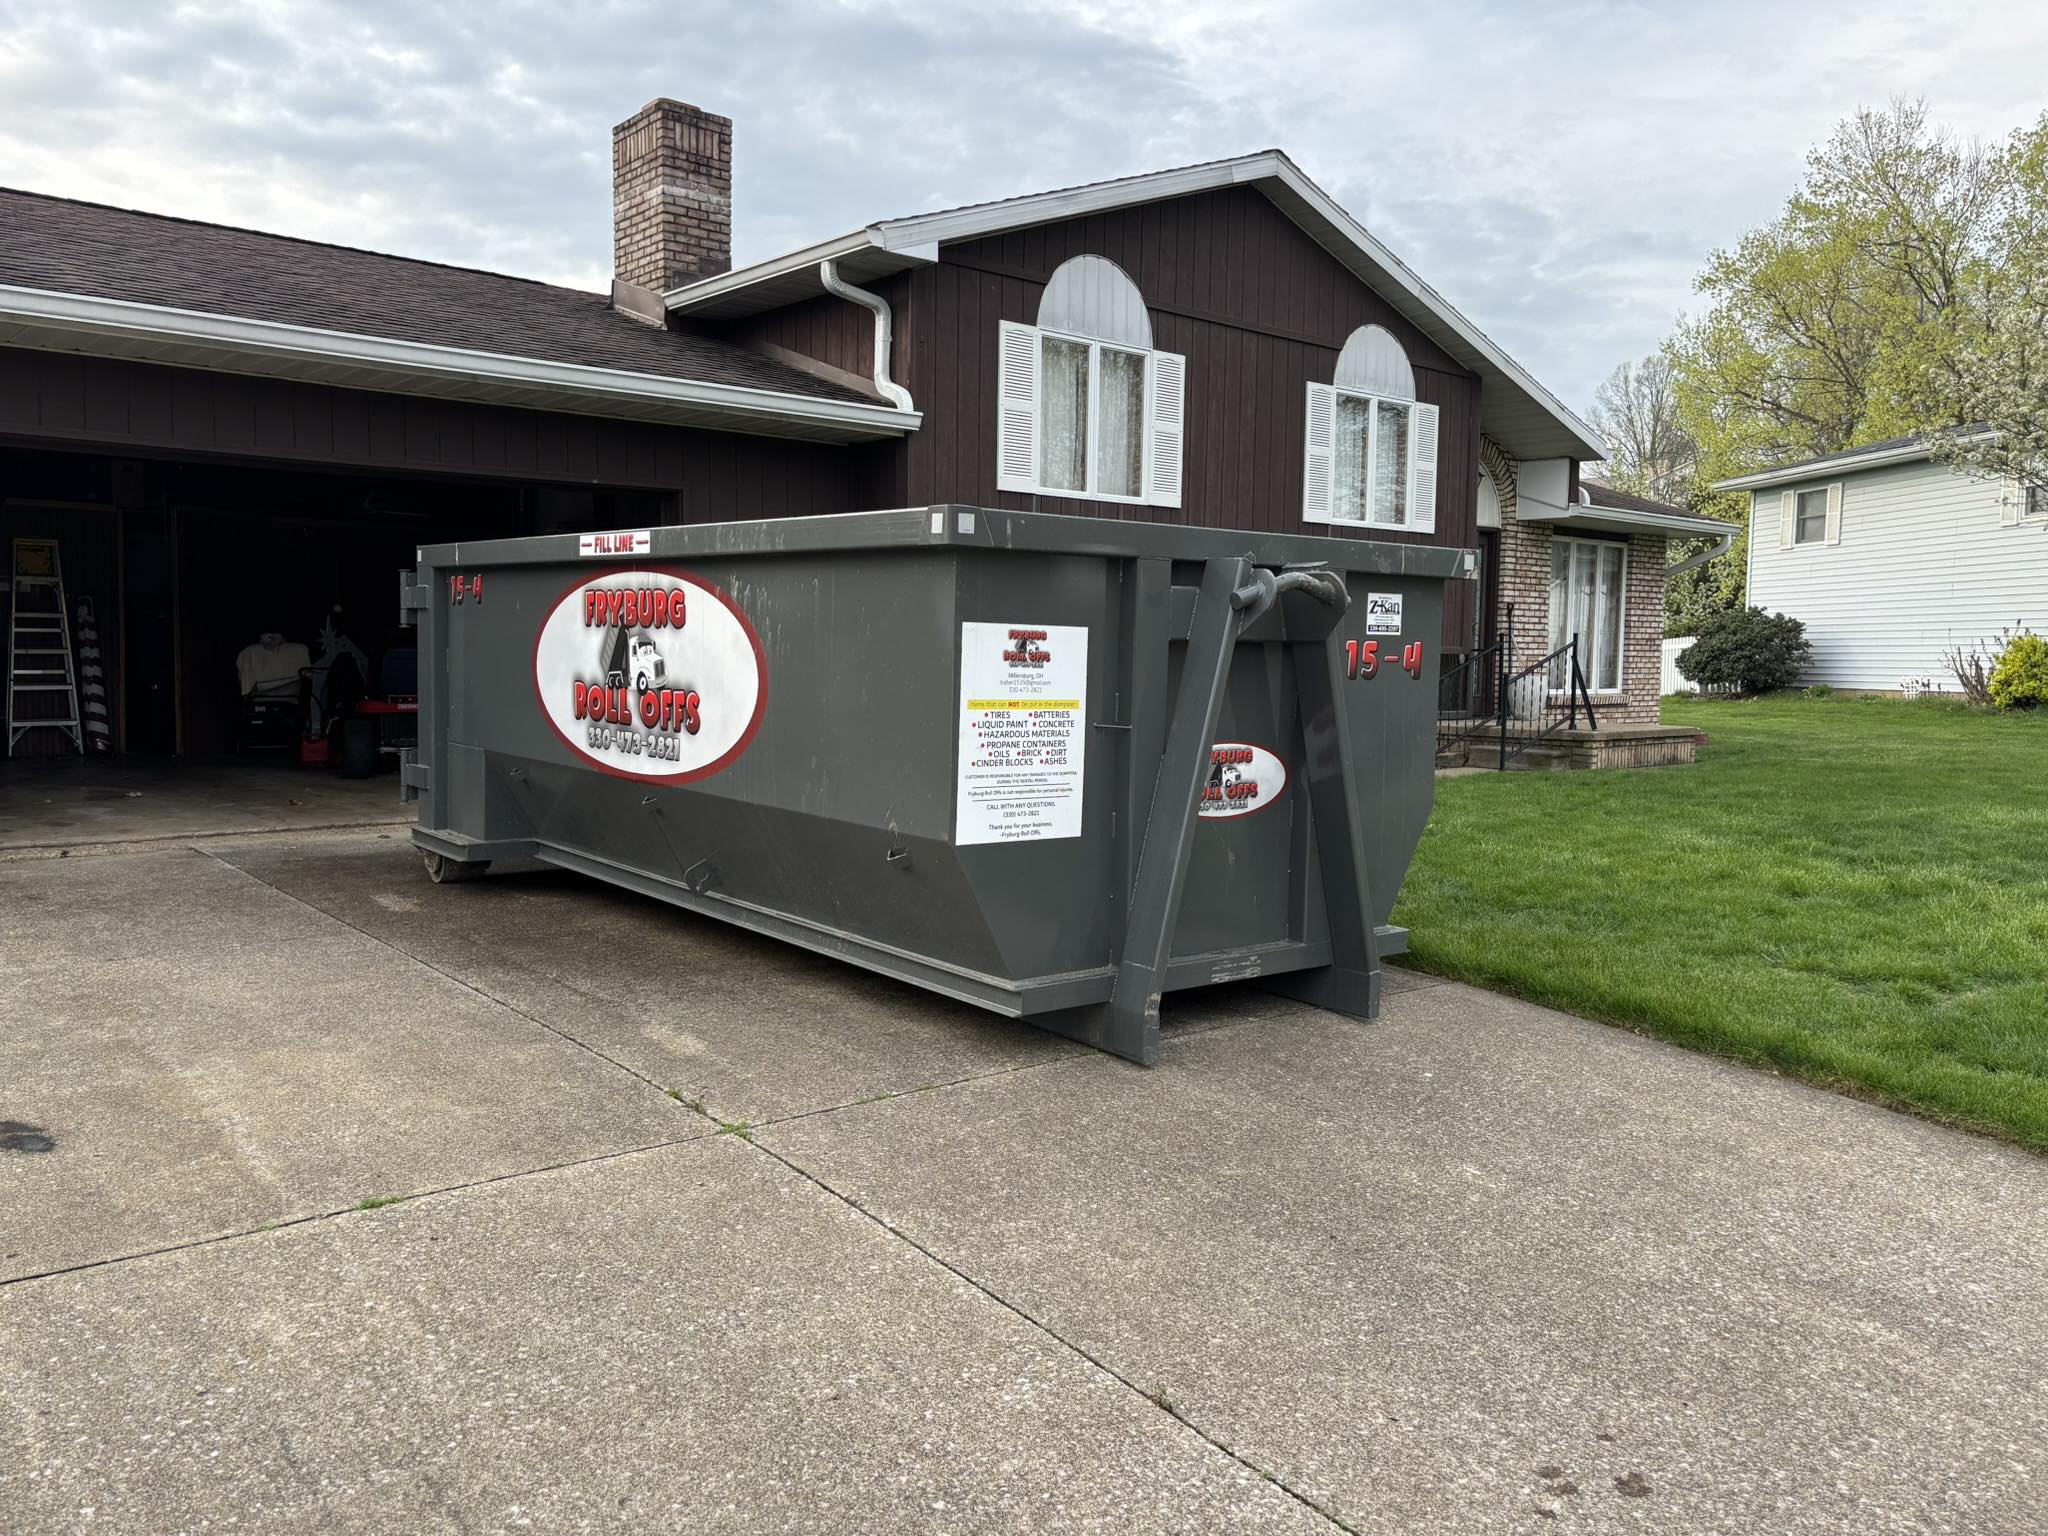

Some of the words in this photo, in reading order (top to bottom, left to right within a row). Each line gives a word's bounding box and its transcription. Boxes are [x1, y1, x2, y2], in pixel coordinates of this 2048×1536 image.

[594, 535, 612, 553] FILL
[614, 534, 634, 552] LINE
[450, 574, 483, 606] 15-4
[585, 588, 686, 629] FRYBURG
[1369, 600, 1400, 615] Z-Kan
[1008, 630, 1047, 640] FRYBURG
[1003, 650, 1028, 662] ROLL
[1029, 650, 1051, 662] OFFS
[1346, 640, 1422, 680] 15-4
[574, 680, 632, 726] ROLL
[640, 689, 701, 735] OFFS
[990, 711, 1011, 719] TIRES
[1034, 711, 1070, 719] BATTERIES
[977, 721, 1004, 730] LIQUID
[1006, 720, 1028, 728] PAINT
[1038, 720, 1075, 728] CONCRETE
[983, 730, 1030, 738] HAZARDOUS
[1032, 730, 1070, 738] MATERIALS
[588, 727, 681, 761] 330-473-2821
[986, 741, 1020, 749] PROPANE
[1022, 740, 1066, 748] CONTAINERS
[994, 750, 1010, 758] OILS
[1021, 749, 1042, 757] BRICK
[1211, 750, 1253, 764] YBURG
[976, 759, 1003, 768] CINDER
[1005, 758, 1033, 766] BLOCKS
[1044, 757, 1067, 765] ASHES
[1226, 784, 1258, 799] OFFS
